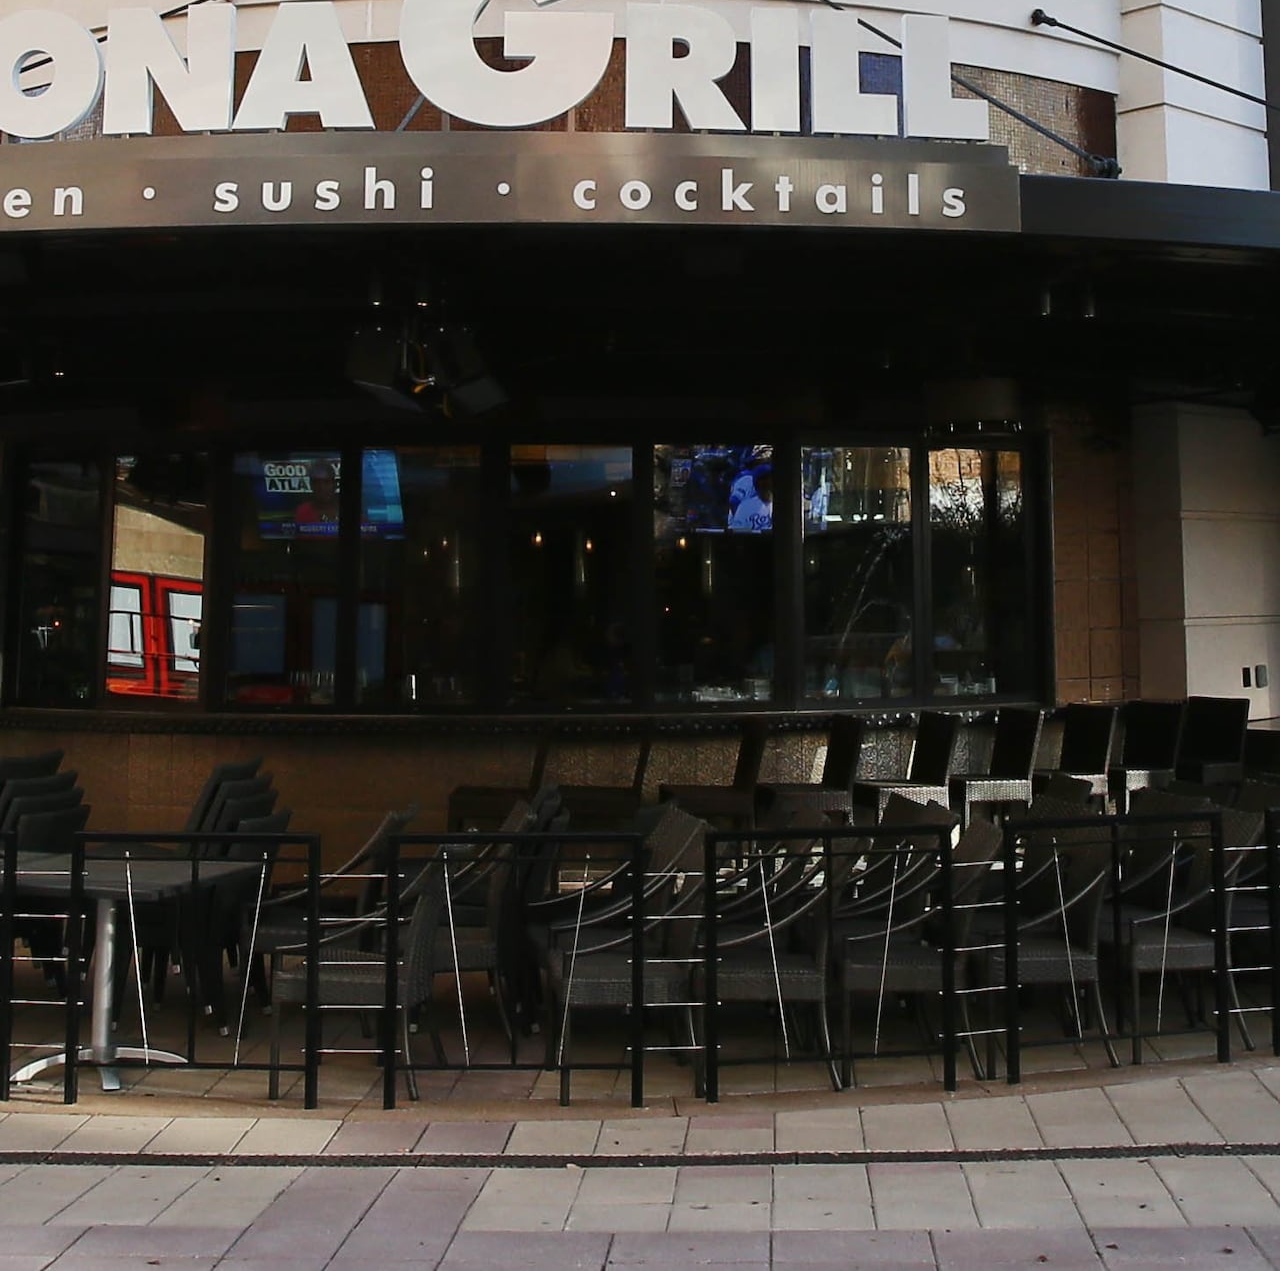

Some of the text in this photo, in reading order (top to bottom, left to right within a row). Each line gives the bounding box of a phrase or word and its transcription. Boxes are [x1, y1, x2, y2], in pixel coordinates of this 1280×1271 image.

[214, 167, 433, 212] sushi
[573, 169, 966, 218] cocktails
[264, 463, 306, 477] GOOD
